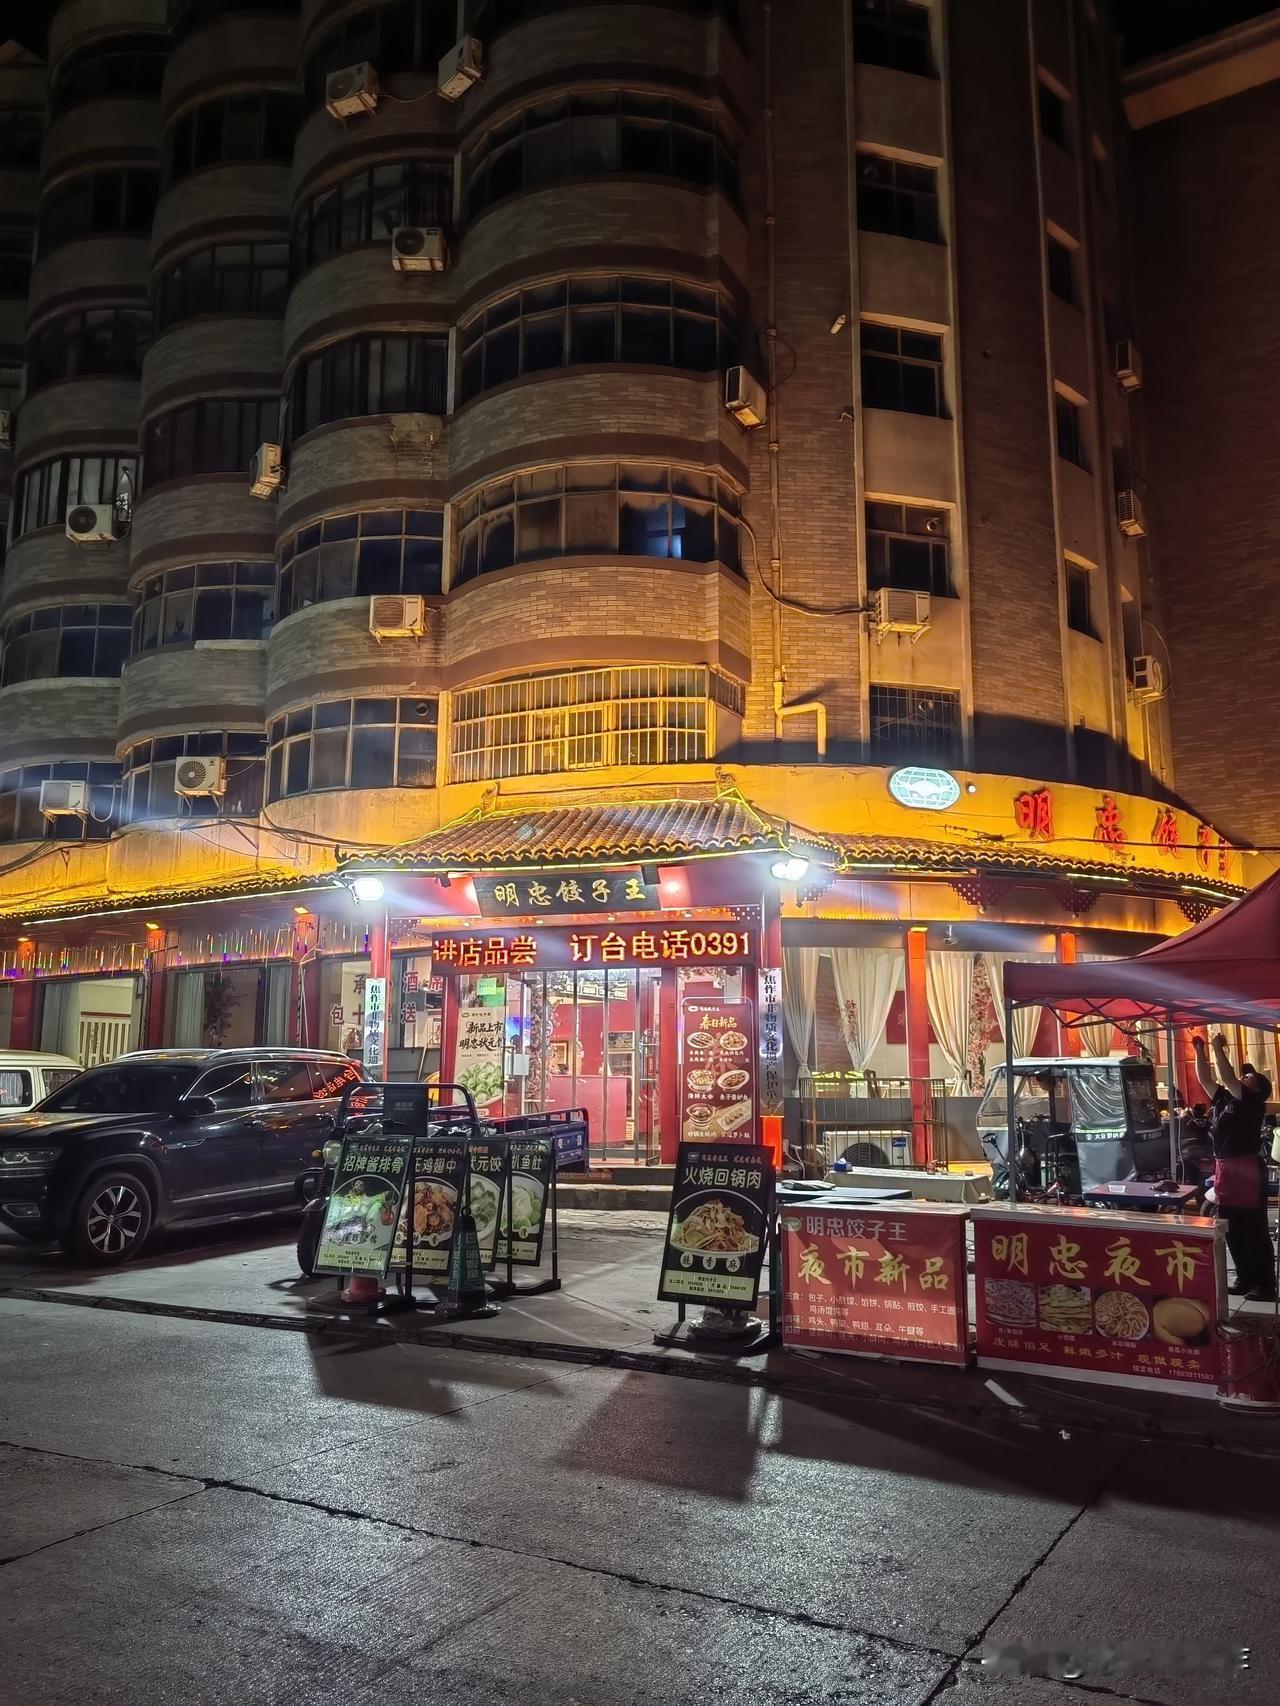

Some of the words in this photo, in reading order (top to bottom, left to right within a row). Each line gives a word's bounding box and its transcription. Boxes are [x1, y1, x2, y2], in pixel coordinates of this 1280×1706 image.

[494, 878, 646, 907] 明忠饺子王
[570, 930, 750, 962] 订台电话0391
[466, 1021, 503, 1035] 新品上市
[342, 1156, 404, 1174] 招牌酱排骨
[682, 1166, 762, 1189] 火烧回锅肉
[806, 1216, 908, 1241] 明忠饺子王
[798, 1243, 949, 1293] 夜市新品
[991, 1232, 1202, 1292] 明忠夜市
